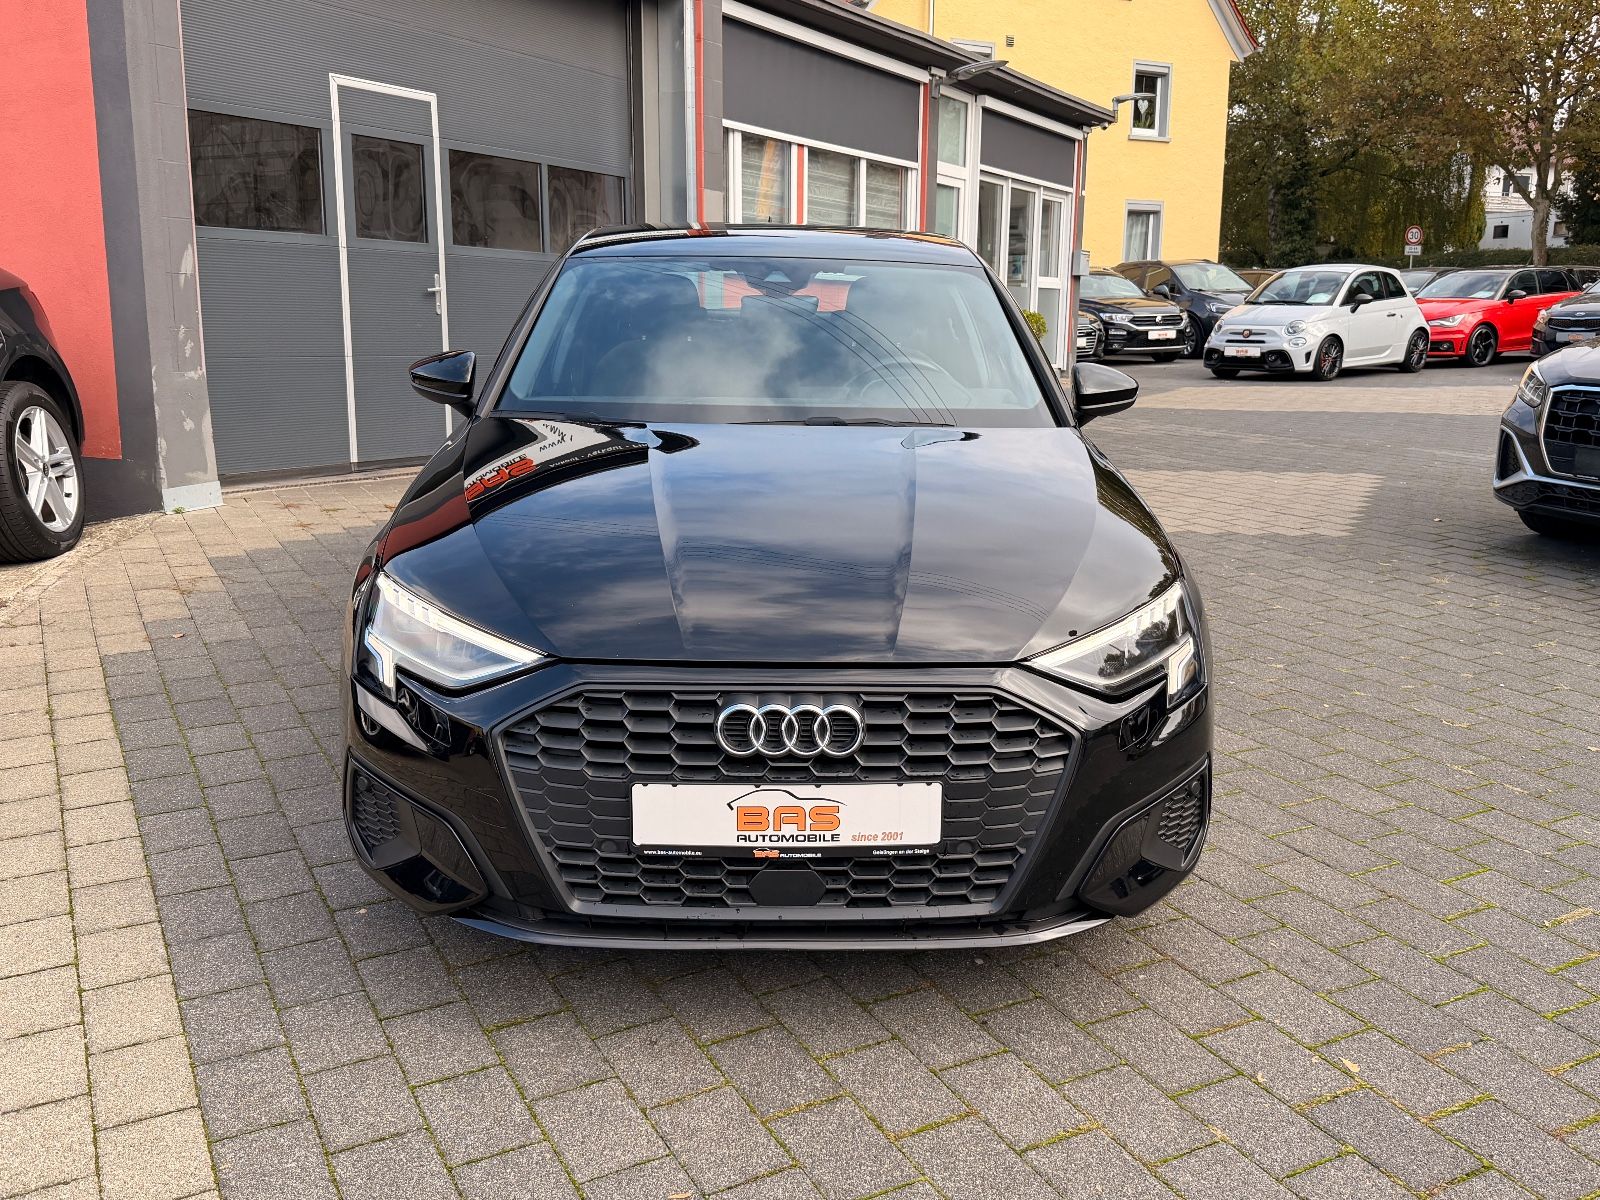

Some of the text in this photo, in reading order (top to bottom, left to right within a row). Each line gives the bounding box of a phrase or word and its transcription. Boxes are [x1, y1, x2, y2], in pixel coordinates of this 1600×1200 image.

[1409, 231, 1418, 239] 30
[736, 805, 841, 832] BAS
[736, 833, 841, 843] AUTOMOBILE
[851, 831, 904, 842] since 2001
